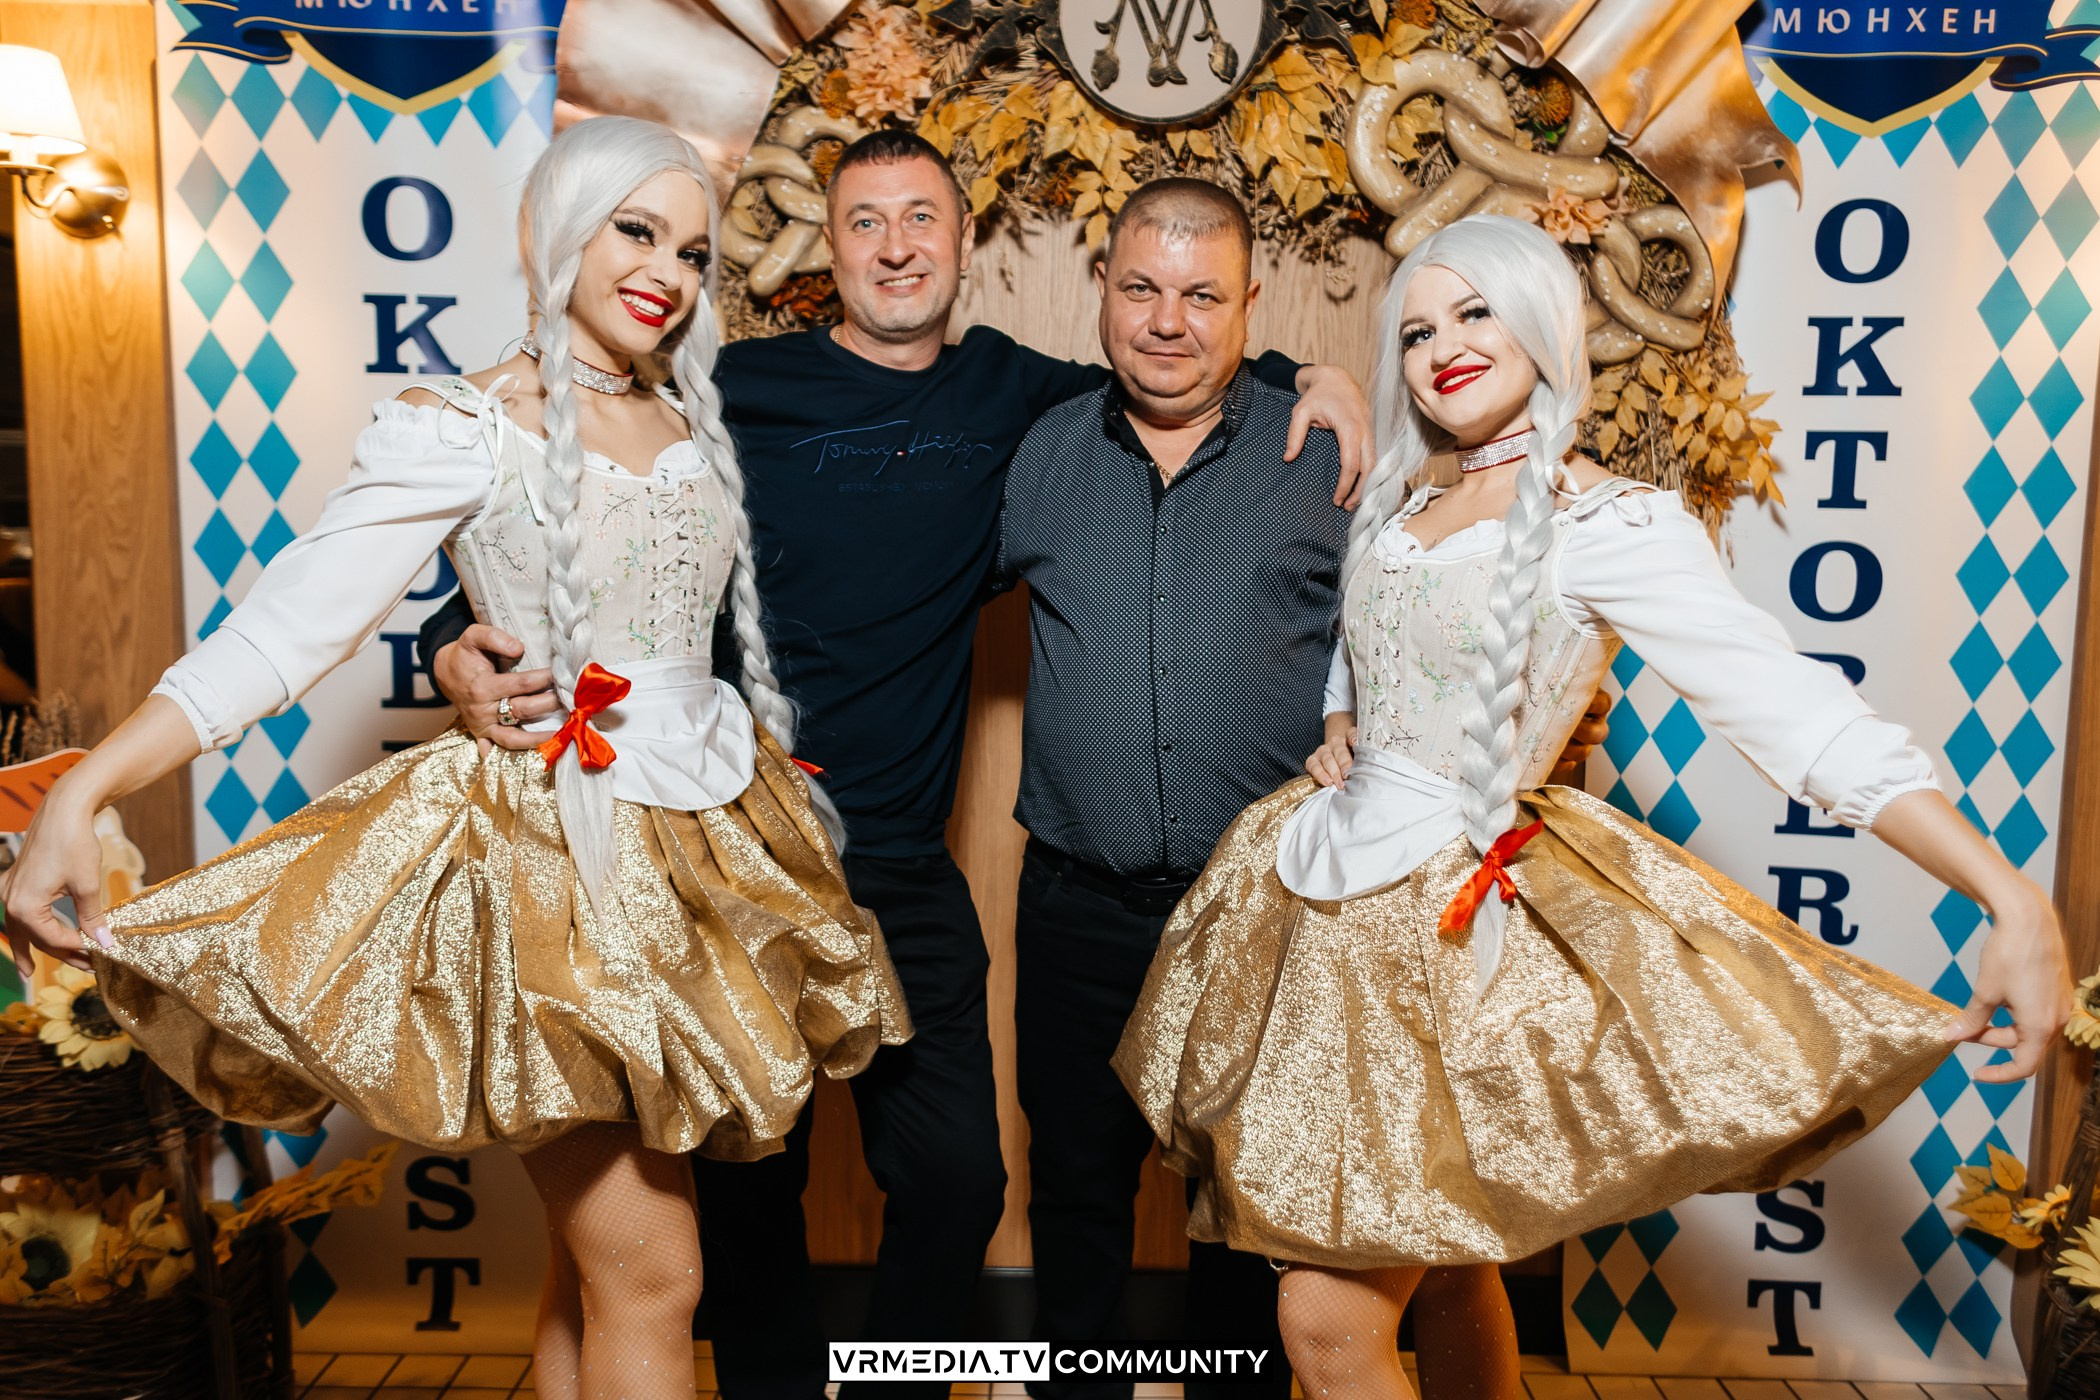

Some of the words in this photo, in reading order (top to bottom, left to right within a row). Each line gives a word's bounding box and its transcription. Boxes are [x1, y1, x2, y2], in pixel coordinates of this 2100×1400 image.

[1772, 8, 1996, 34] МЮНХЕН
[838, 482, 906, 493] ESTABLSED
[1747, 198, 1910, 1357] OKTORST
